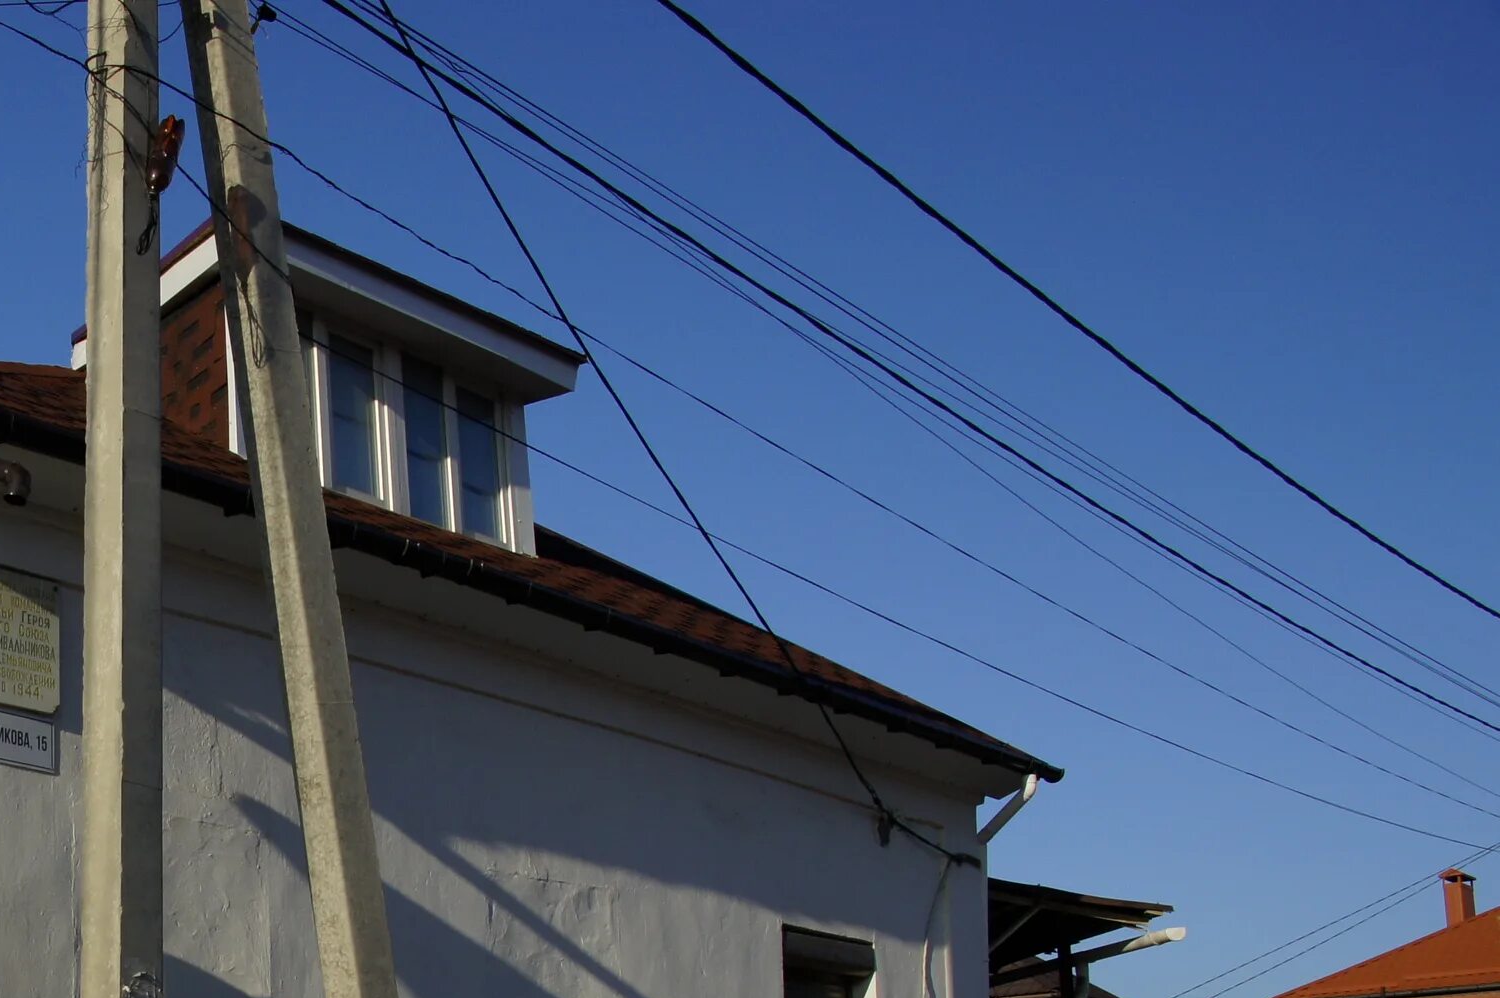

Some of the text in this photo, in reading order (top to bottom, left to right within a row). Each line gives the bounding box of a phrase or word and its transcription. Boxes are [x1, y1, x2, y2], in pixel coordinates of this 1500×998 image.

[21, 610, 51, 629] ГЕРОЯ
[18, 624, 50, 643] СОЮЗА
[37, 735, 48, 752] 15
